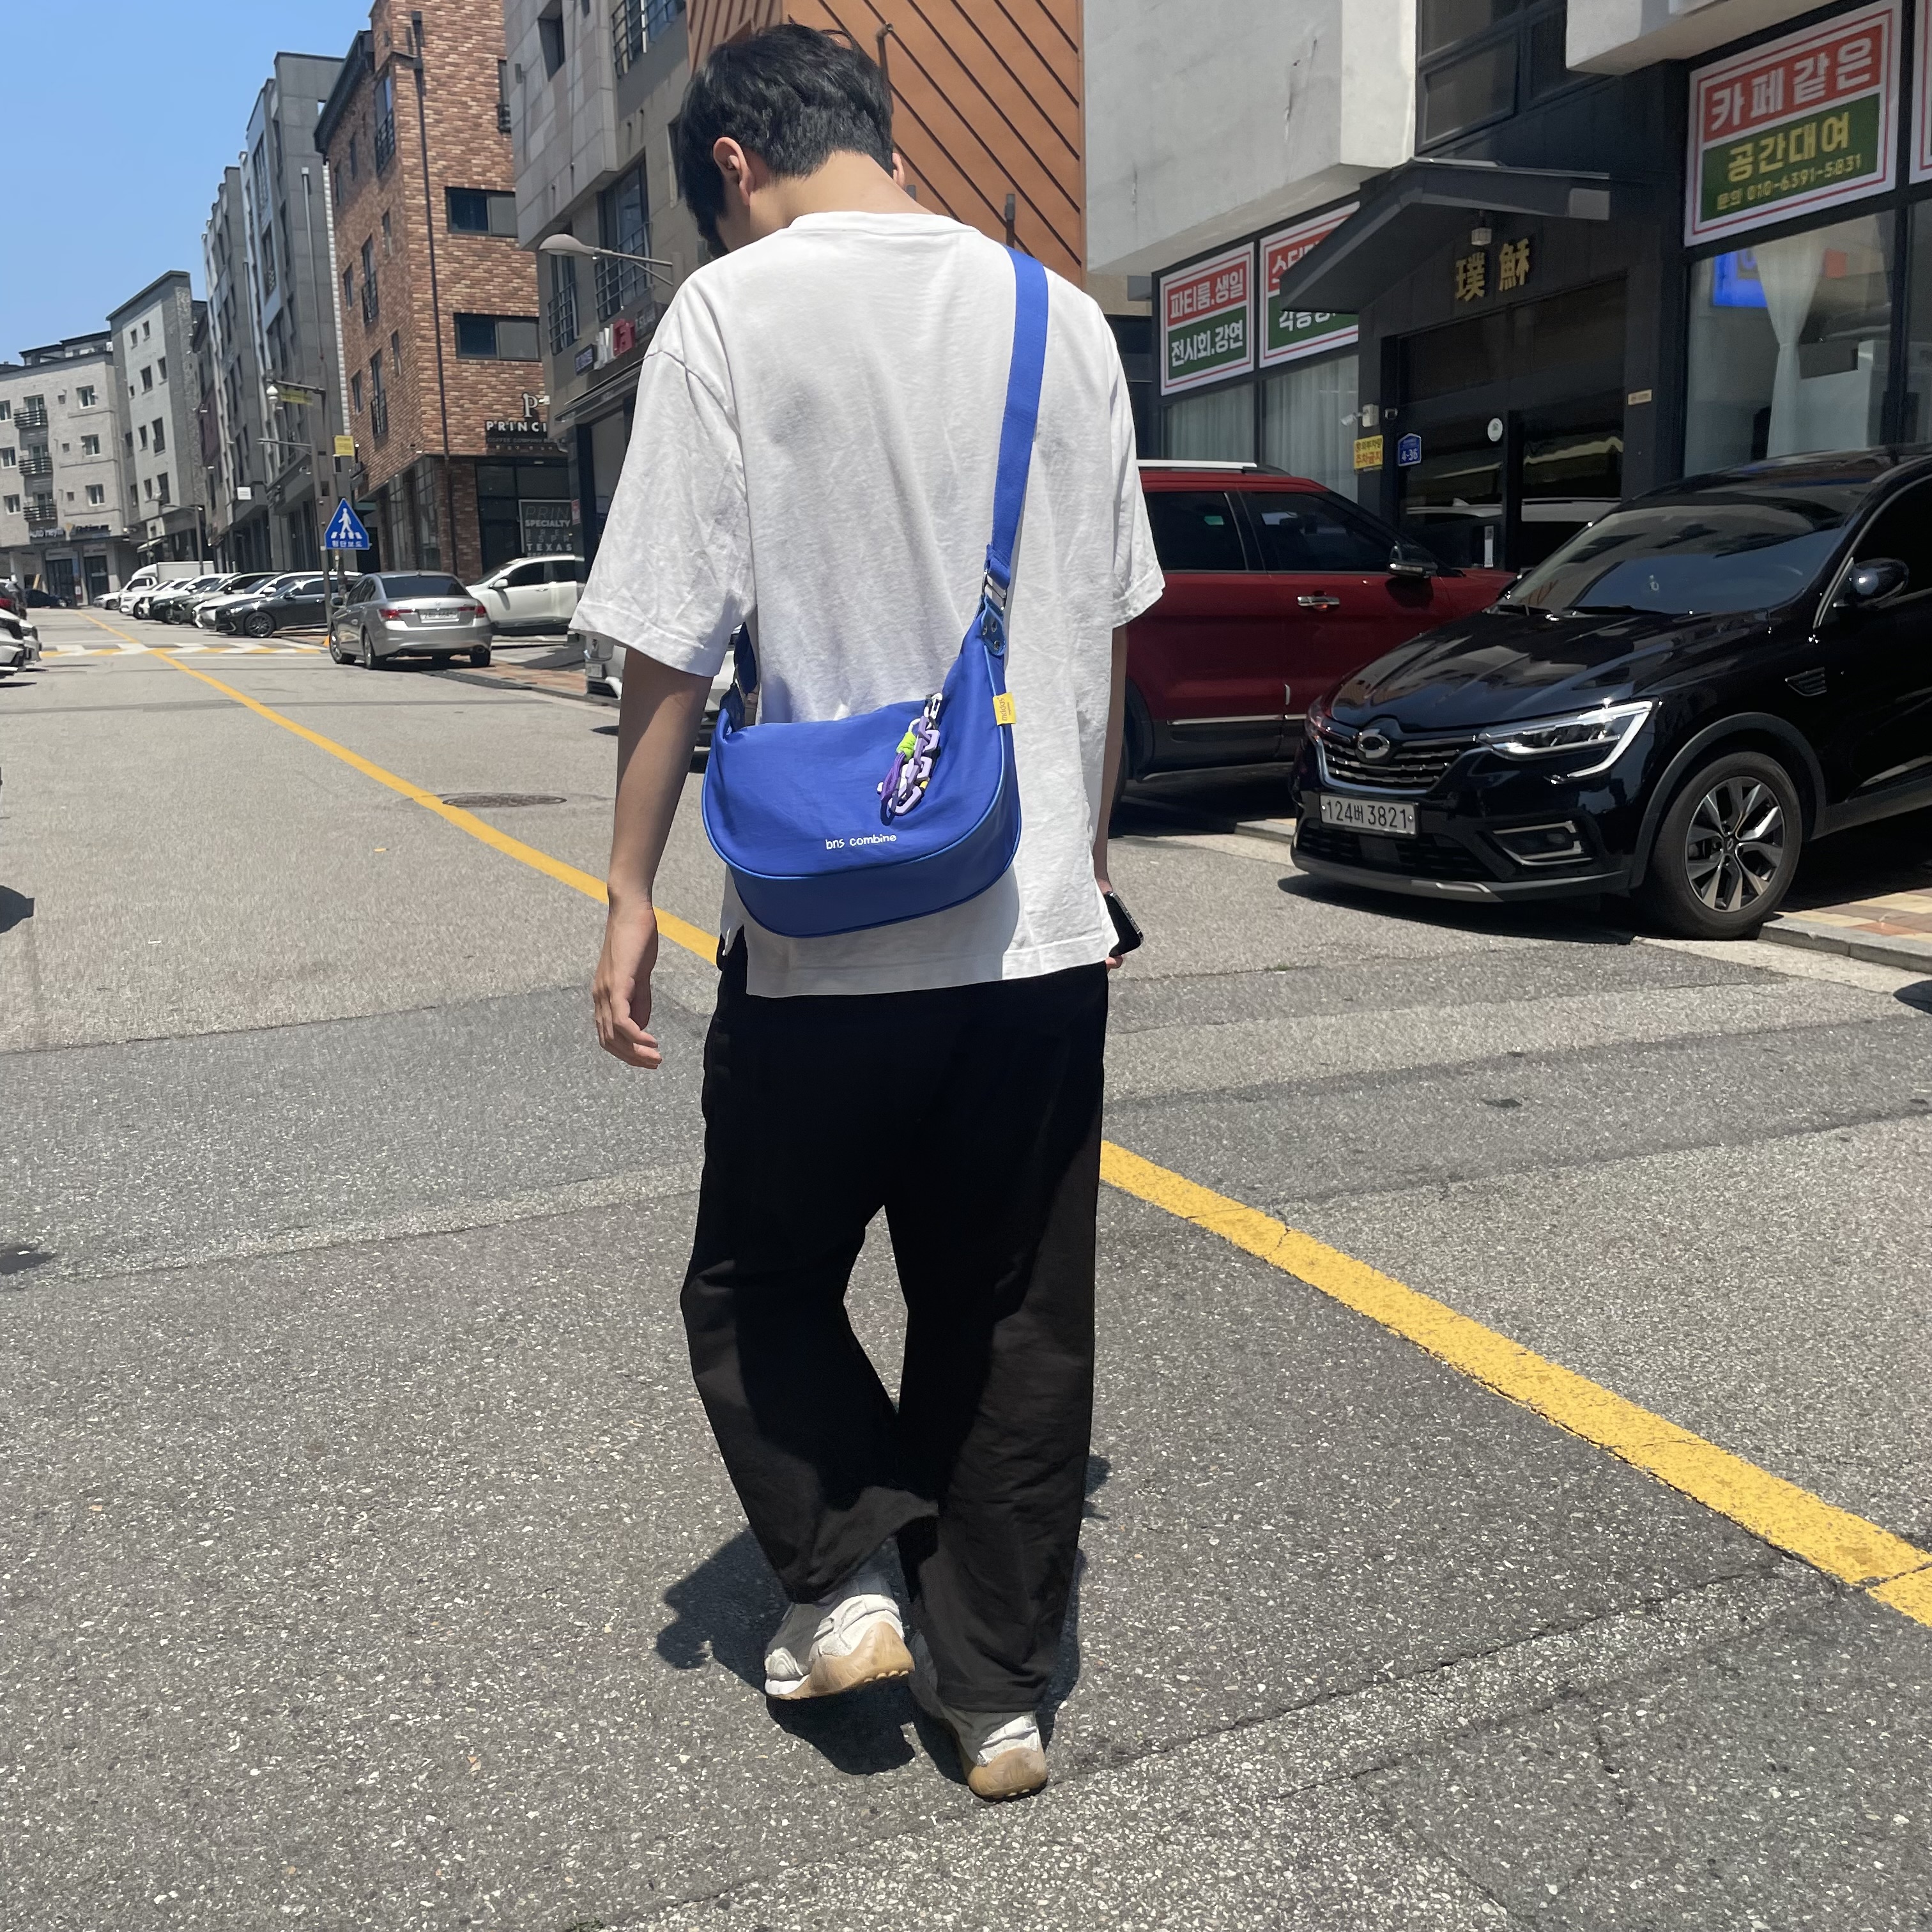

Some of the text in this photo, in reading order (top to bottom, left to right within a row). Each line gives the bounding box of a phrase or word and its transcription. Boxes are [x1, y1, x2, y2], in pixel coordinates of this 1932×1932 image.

[1728, 111, 1850, 183] 공간대여
[1170, 268, 1244, 319] 파티룸.생일
[1171, 319, 1243, 367] 전시회.강연
[526, 543, 572, 551] TEXAS
[849, 833, 897, 847] combine
